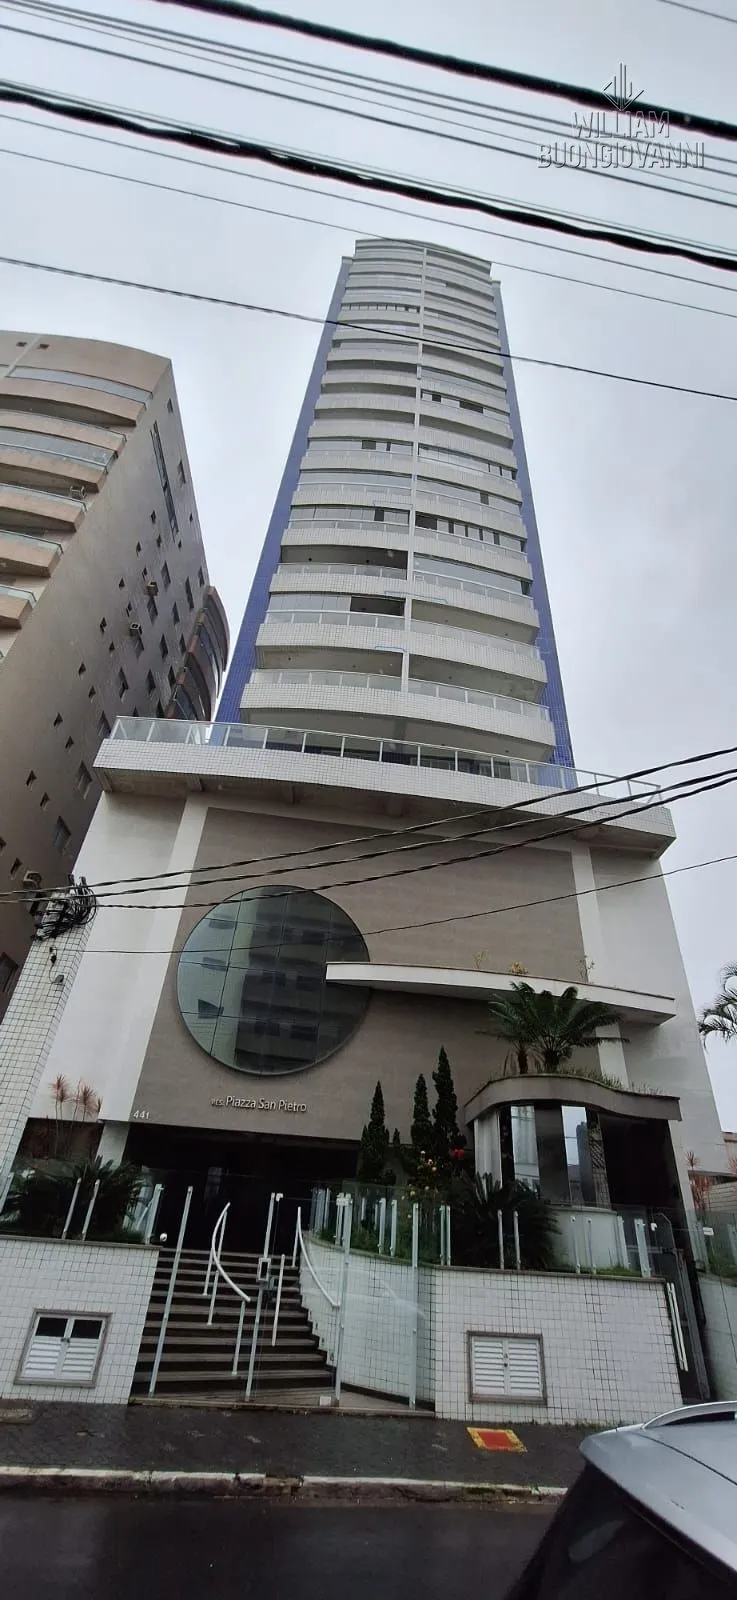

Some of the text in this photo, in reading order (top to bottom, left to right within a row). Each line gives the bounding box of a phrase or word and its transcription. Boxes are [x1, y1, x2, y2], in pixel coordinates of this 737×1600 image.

[225, 1095, 256, 1109] Piazza
[258, 1098, 276, 1110] San
[278, 1099, 307, 1112] Pietro
[133, 1109, 149, 1119] 441
